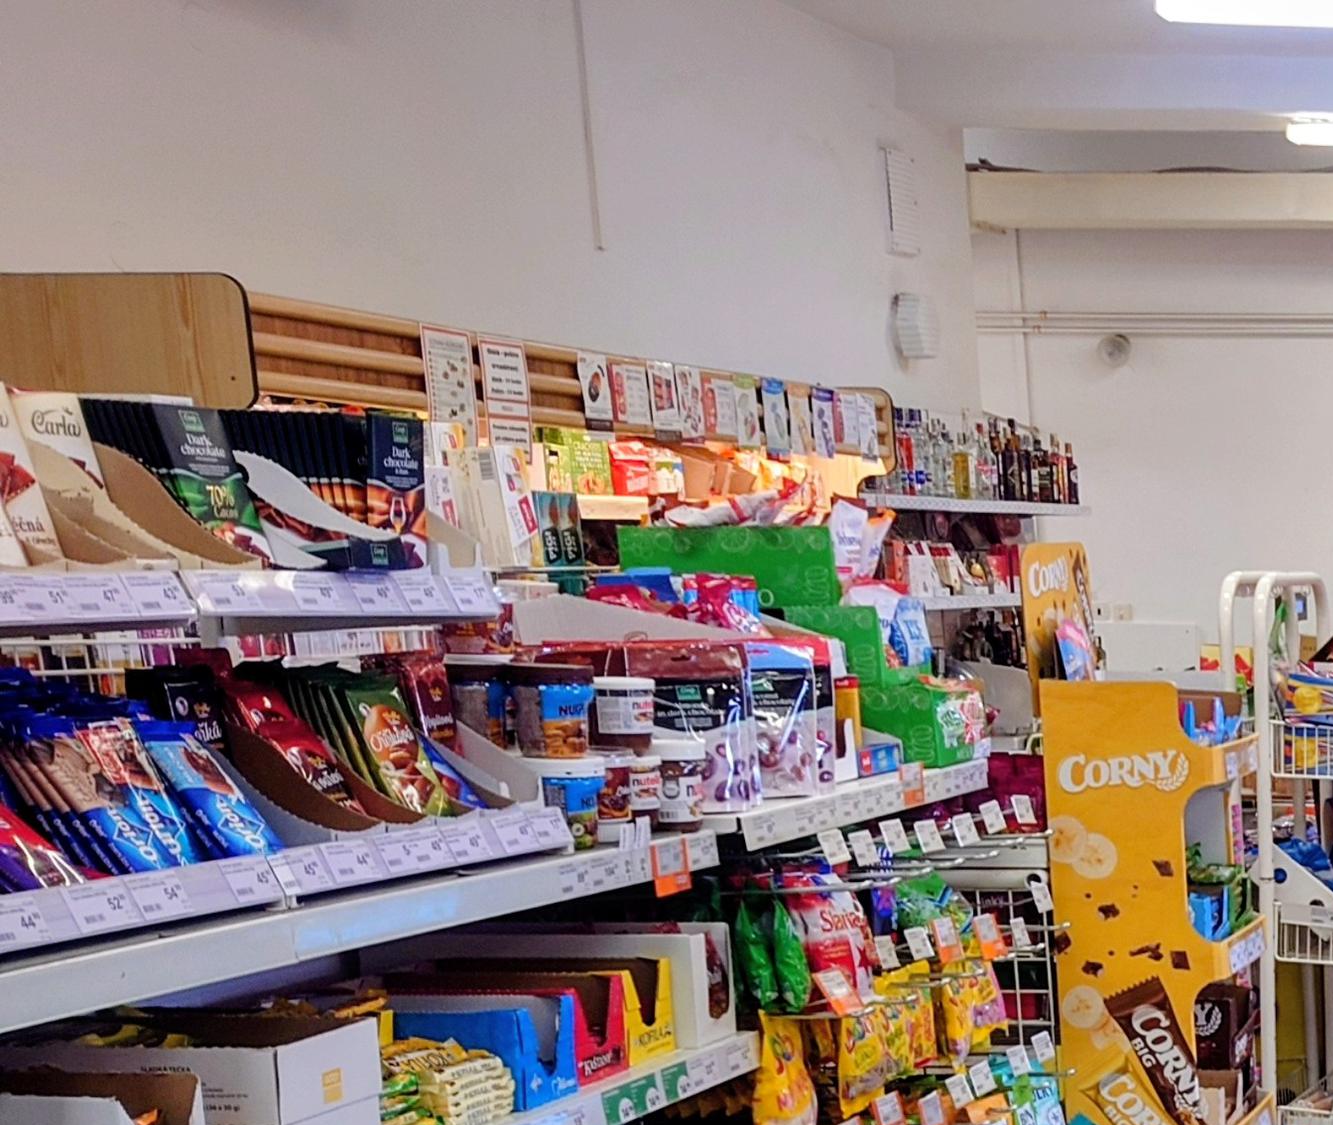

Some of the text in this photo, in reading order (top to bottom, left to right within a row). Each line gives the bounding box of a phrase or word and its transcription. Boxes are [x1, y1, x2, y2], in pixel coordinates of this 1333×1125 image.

[31, 410, 82, 438] Carla
[391, 445, 411, 460] Dark
[1058, 749, 1180, 794] CORNY
[1132, 1036, 1158, 1068] BIG
